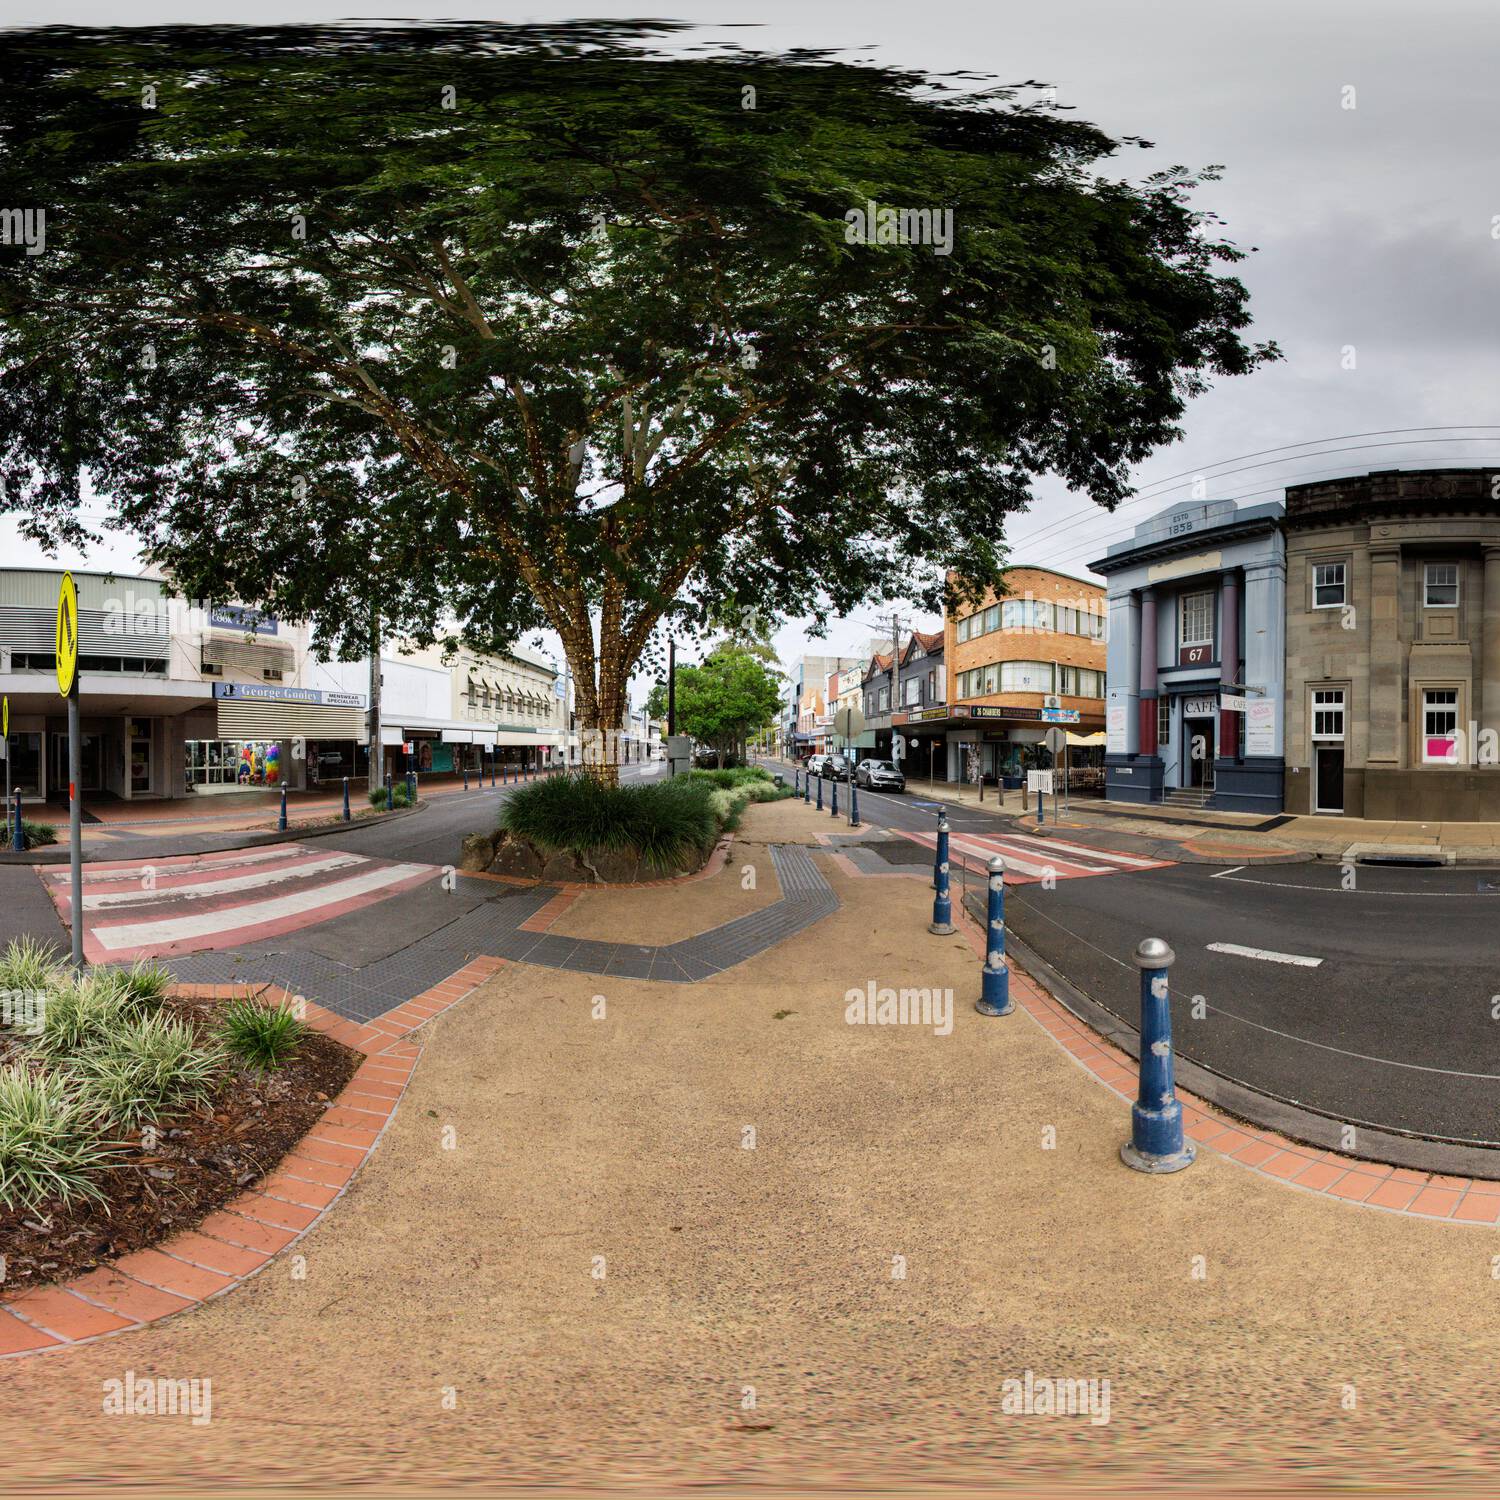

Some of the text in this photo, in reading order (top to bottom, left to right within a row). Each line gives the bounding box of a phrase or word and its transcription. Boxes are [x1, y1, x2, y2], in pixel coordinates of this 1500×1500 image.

[1173, 513, 1189, 523] ESTD
[1169, 521, 1193, 536] 1858
[211, 615, 233, 625] COOK
[1189, 648, 1203, 661] 67
[241, 685, 280, 698] George
[327, 697, 360, 705] SPECIALISTS
